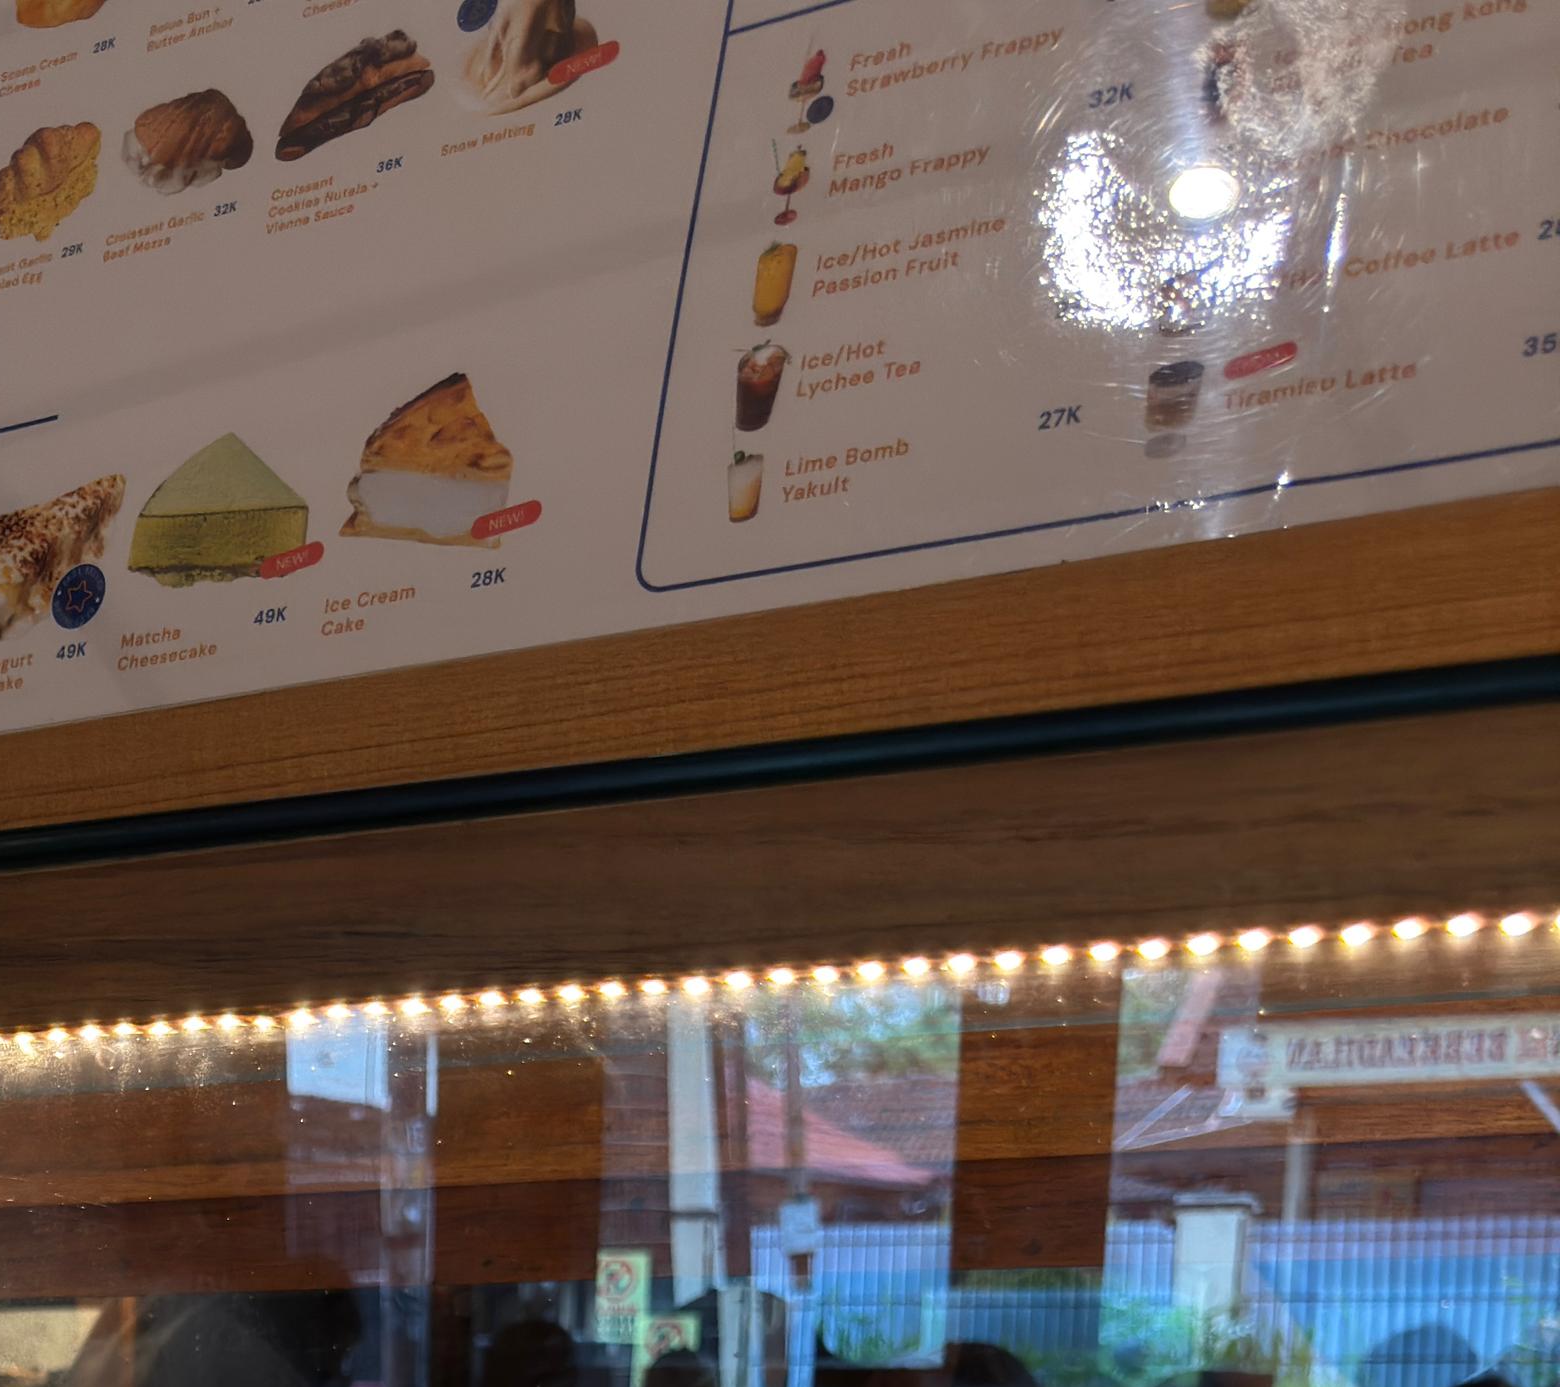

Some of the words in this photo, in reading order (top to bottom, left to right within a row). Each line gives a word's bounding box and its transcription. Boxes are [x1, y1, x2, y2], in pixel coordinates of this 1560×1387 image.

[39, 51, 78, 70] Cream
[846, 51, 974, 97] Strawberry
[979, 26, 1065, 61] Frappy
[849, 41, 912, 72] Fresh
[1088, 81, 1135, 108] 32K
[440, 136, 478, 157] Snow
[482, 122, 536, 145] Melting
[832, 142, 894, 171] Fresh
[828, 167, 903, 198] Mango
[909, 144, 991, 177] Frappy
[271, 175, 334, 201] Croissant
[268, 198, 321, 218] Cookies
[105, 220, 163, 246] Croissant
[815, 239, 903, 273] Ice/Hot
[908, 217, 1007, 251] Jasmine
[1344, 247, 1436, 278] Coffee
[1445, 230, 1521, 261] Latte
[811, 267, 898, 298] Passion
[904, 250, 960, 277] Fruit
[800, 339, 887, 371] Ice/Hot
[796, 369, 875, 400] Lychee
[884, 360, 922, 380] Tea
[1344, 362, 1417, 390] Latte
[1038, 403, 1083, 431] 27K
[784, 455, 838, 477] Lime
[845, 437, 910, 466] Bomb
[781, 476, 851, 504] Yakult
[488, 509, 525, 531] NEW!
[470, 567, 507, 589] 28K
[324, 597, 351, 615] Ice
[357, 584, 416, 609] Cream
[253, 605, 288, 625] 49K
[321, 616, 365, 637] Cake
[56, 641, 88, 661] 49K
[120, 627, 182, 649] Matcha
[117, 641, 217, 672] Cheesecake
